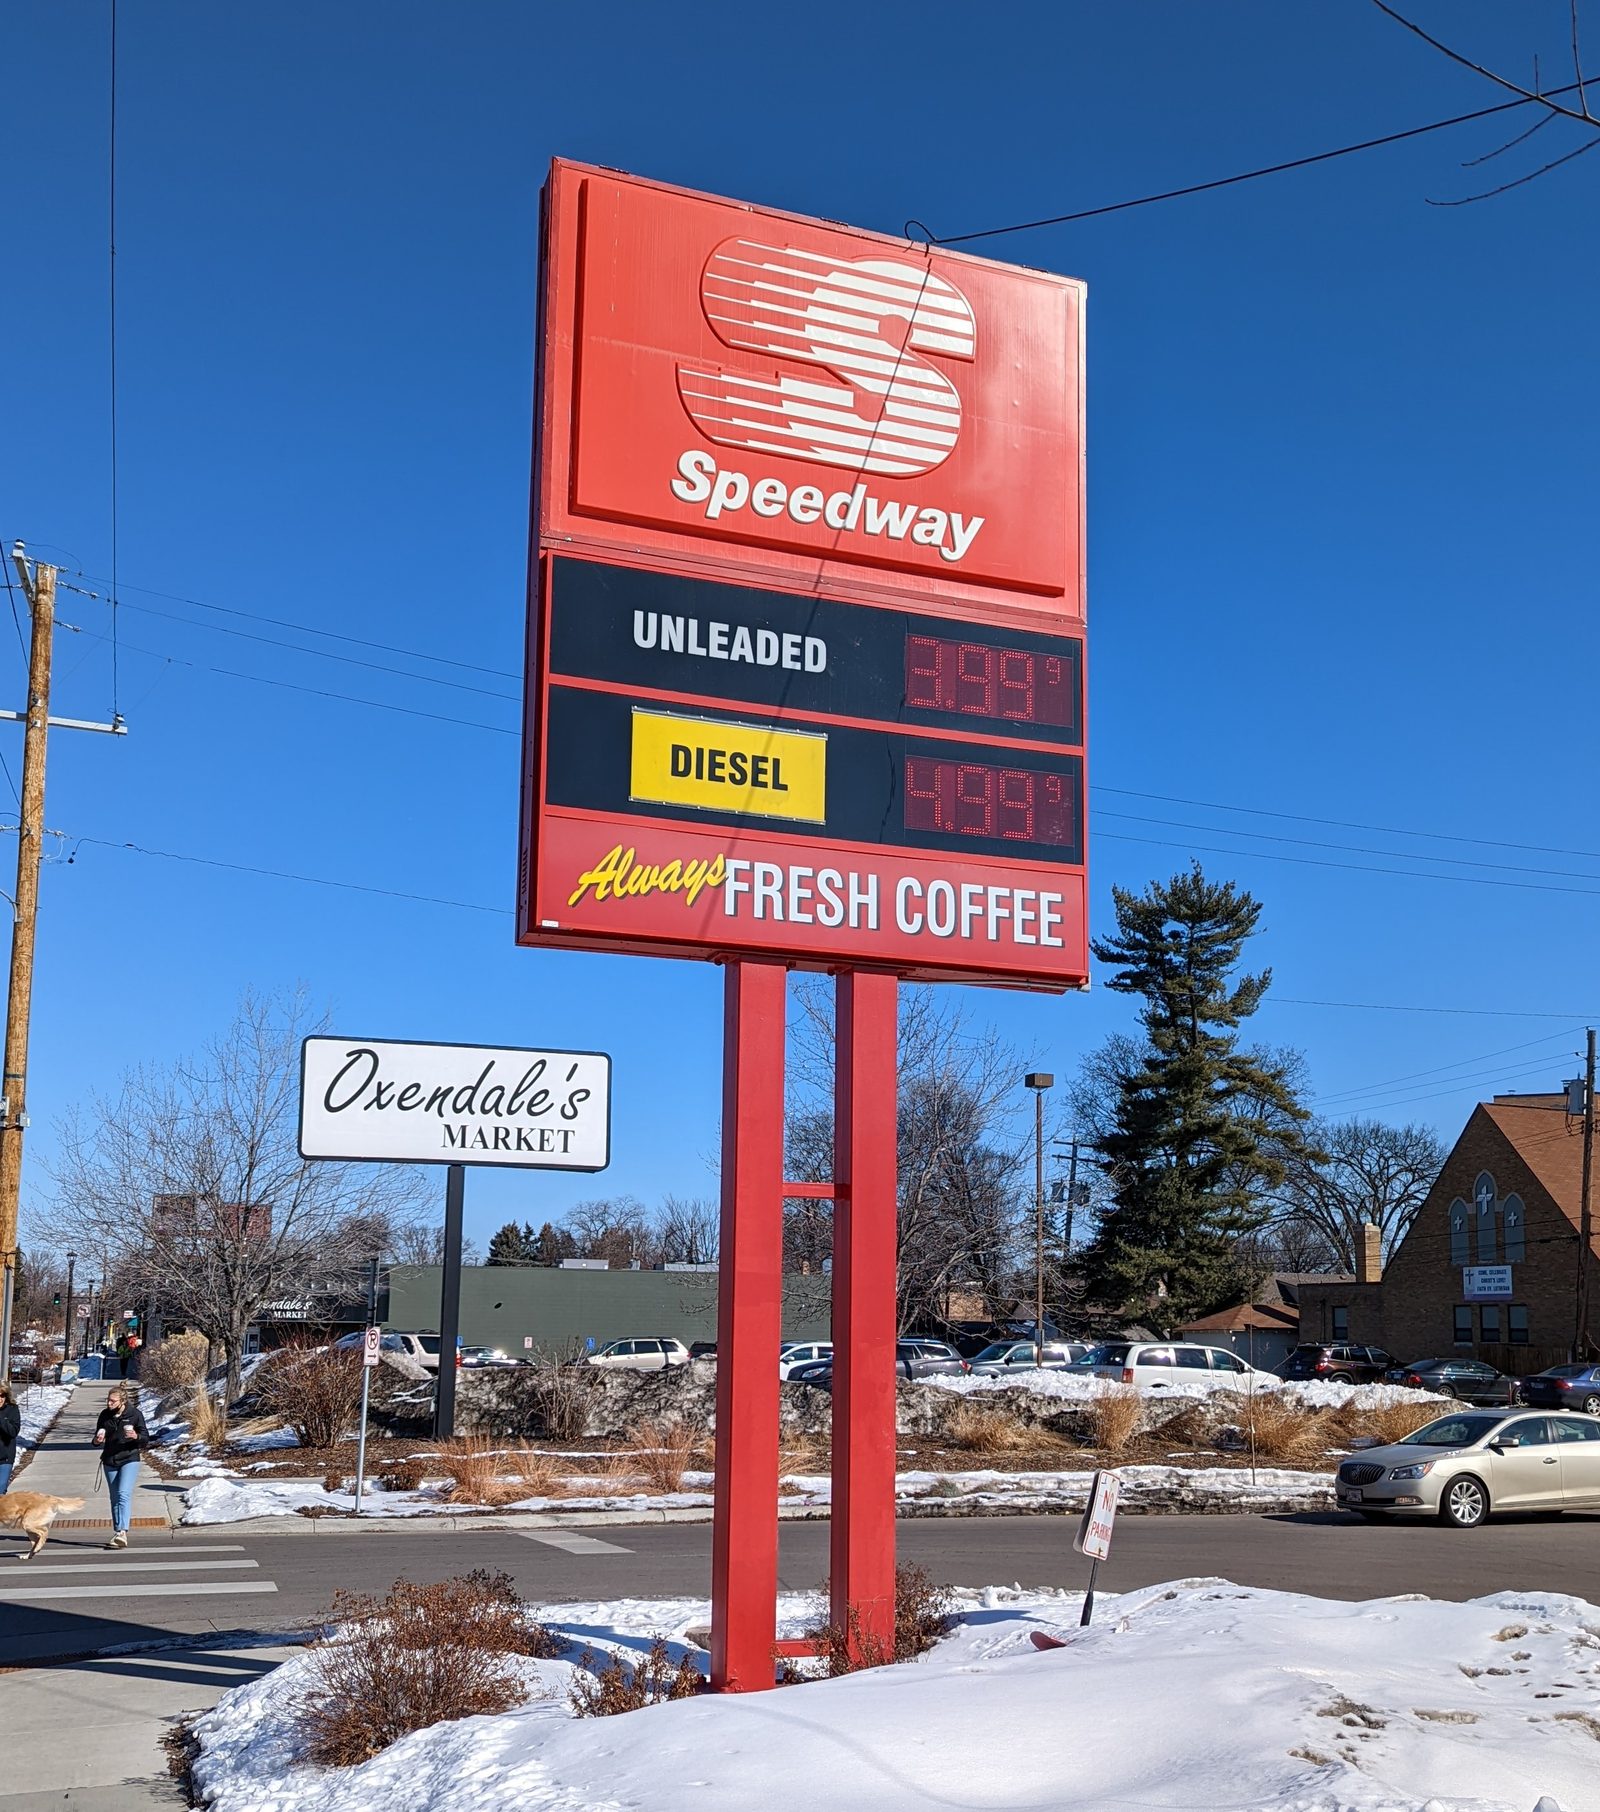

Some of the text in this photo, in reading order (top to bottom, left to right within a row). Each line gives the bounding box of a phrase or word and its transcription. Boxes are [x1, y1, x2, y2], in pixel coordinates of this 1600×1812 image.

[670, 449, 986, 561] Speedway
[632, 609, 828, 674] UNLEADED
[671, 744, 788, 792] DIESEL
[567, 844, 1065, 948] Always FRESH COFFEE
[323, 1048, 591, 1120] Oxendale's
[440, 1123, 576, 1154] MARKET
[252, 1293, 313, 1310] endale's
[273, 1310, 307, 1319] MARKET
[1102, 1490, 1114, 1512] NO
[1090, 1521, 1111, 1541] PARKING
